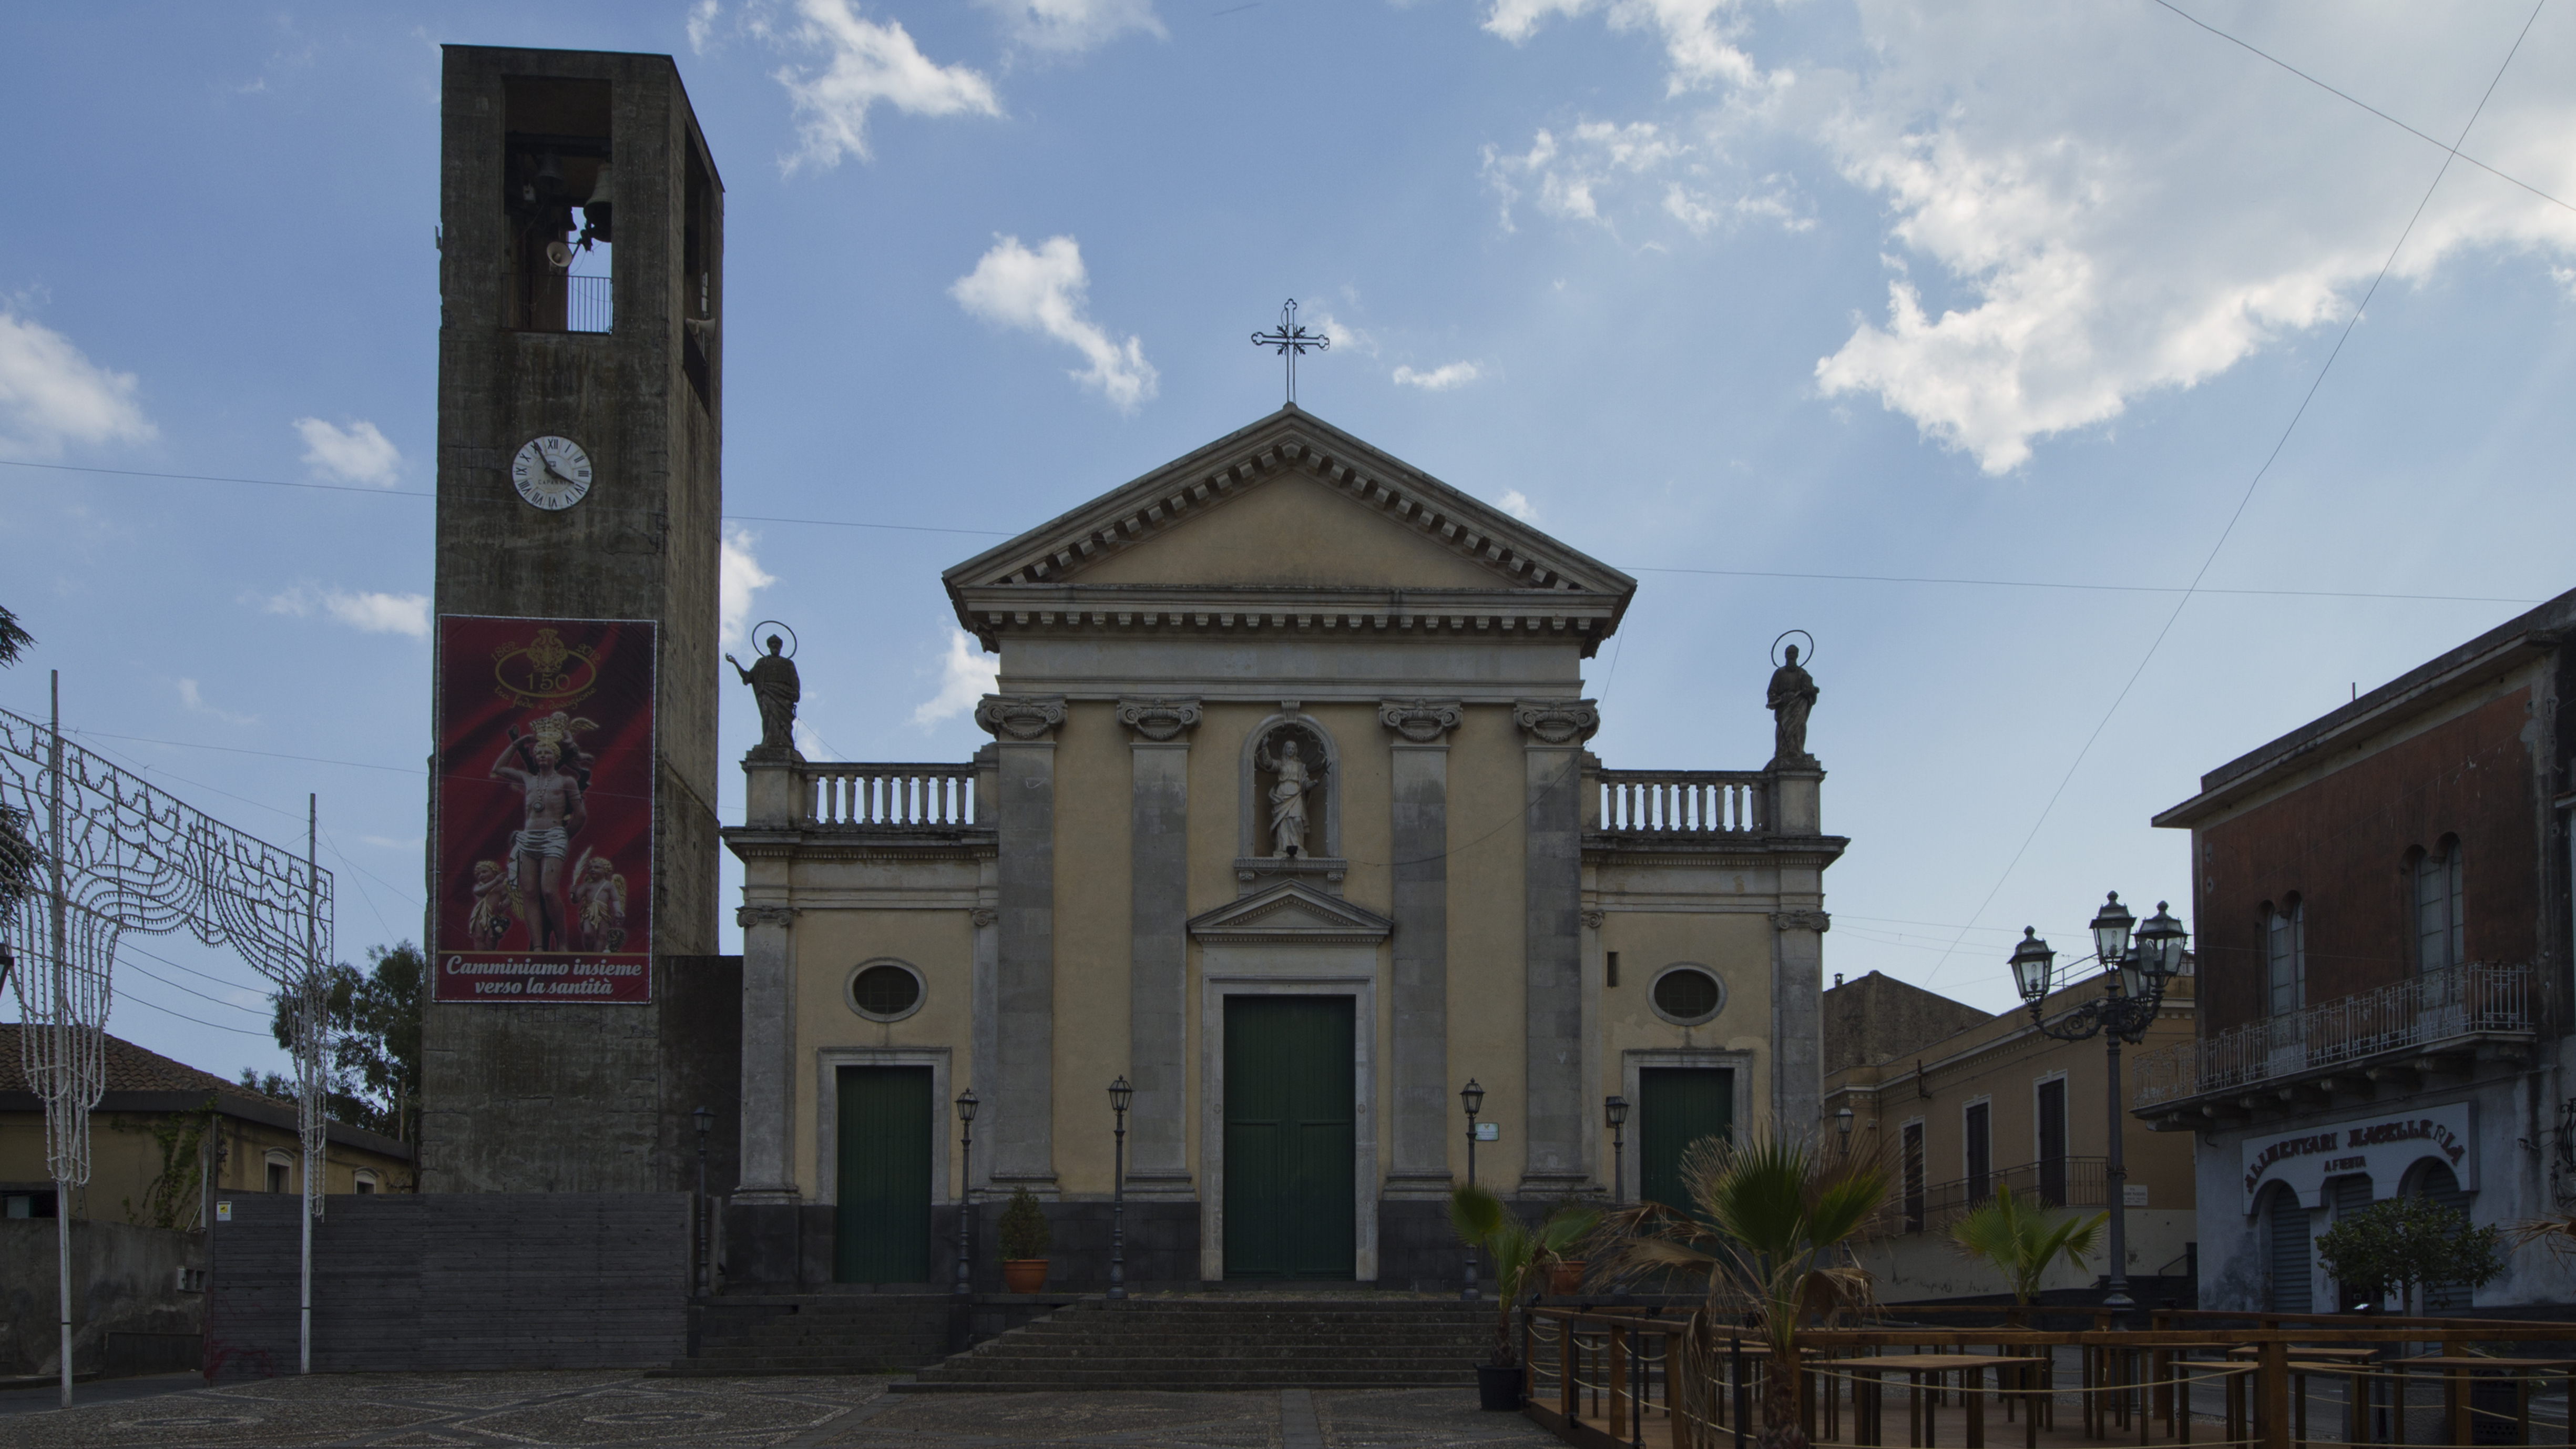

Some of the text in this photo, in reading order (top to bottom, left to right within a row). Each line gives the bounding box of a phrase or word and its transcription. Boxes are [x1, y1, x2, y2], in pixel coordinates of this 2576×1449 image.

[548, 438, 558, 450] XII
[519, 453, 531, 463] X
[574, 455, 585, 463] II
[516, 467, 527, 476] IX
[531, 492, 544, 506] VII
[548, 496, 558, 508] VI
[565, 494, 573, 505] V
[490, 641, 520, 662] 1862
[575, 642, 601, 665] 2012
[526, 672, 571, 691] 150
[494, 685, 510, 701] tra
[509, 693, 535, 709] fede
[548, 687, 597, 710] devozione
[446, 955, 642, 976] Camminiamo insieme
[475, 977, 614, 995] verso la santità
[2245, 1119, 2466, 1194] ALIMENTARI MACELLERIA
